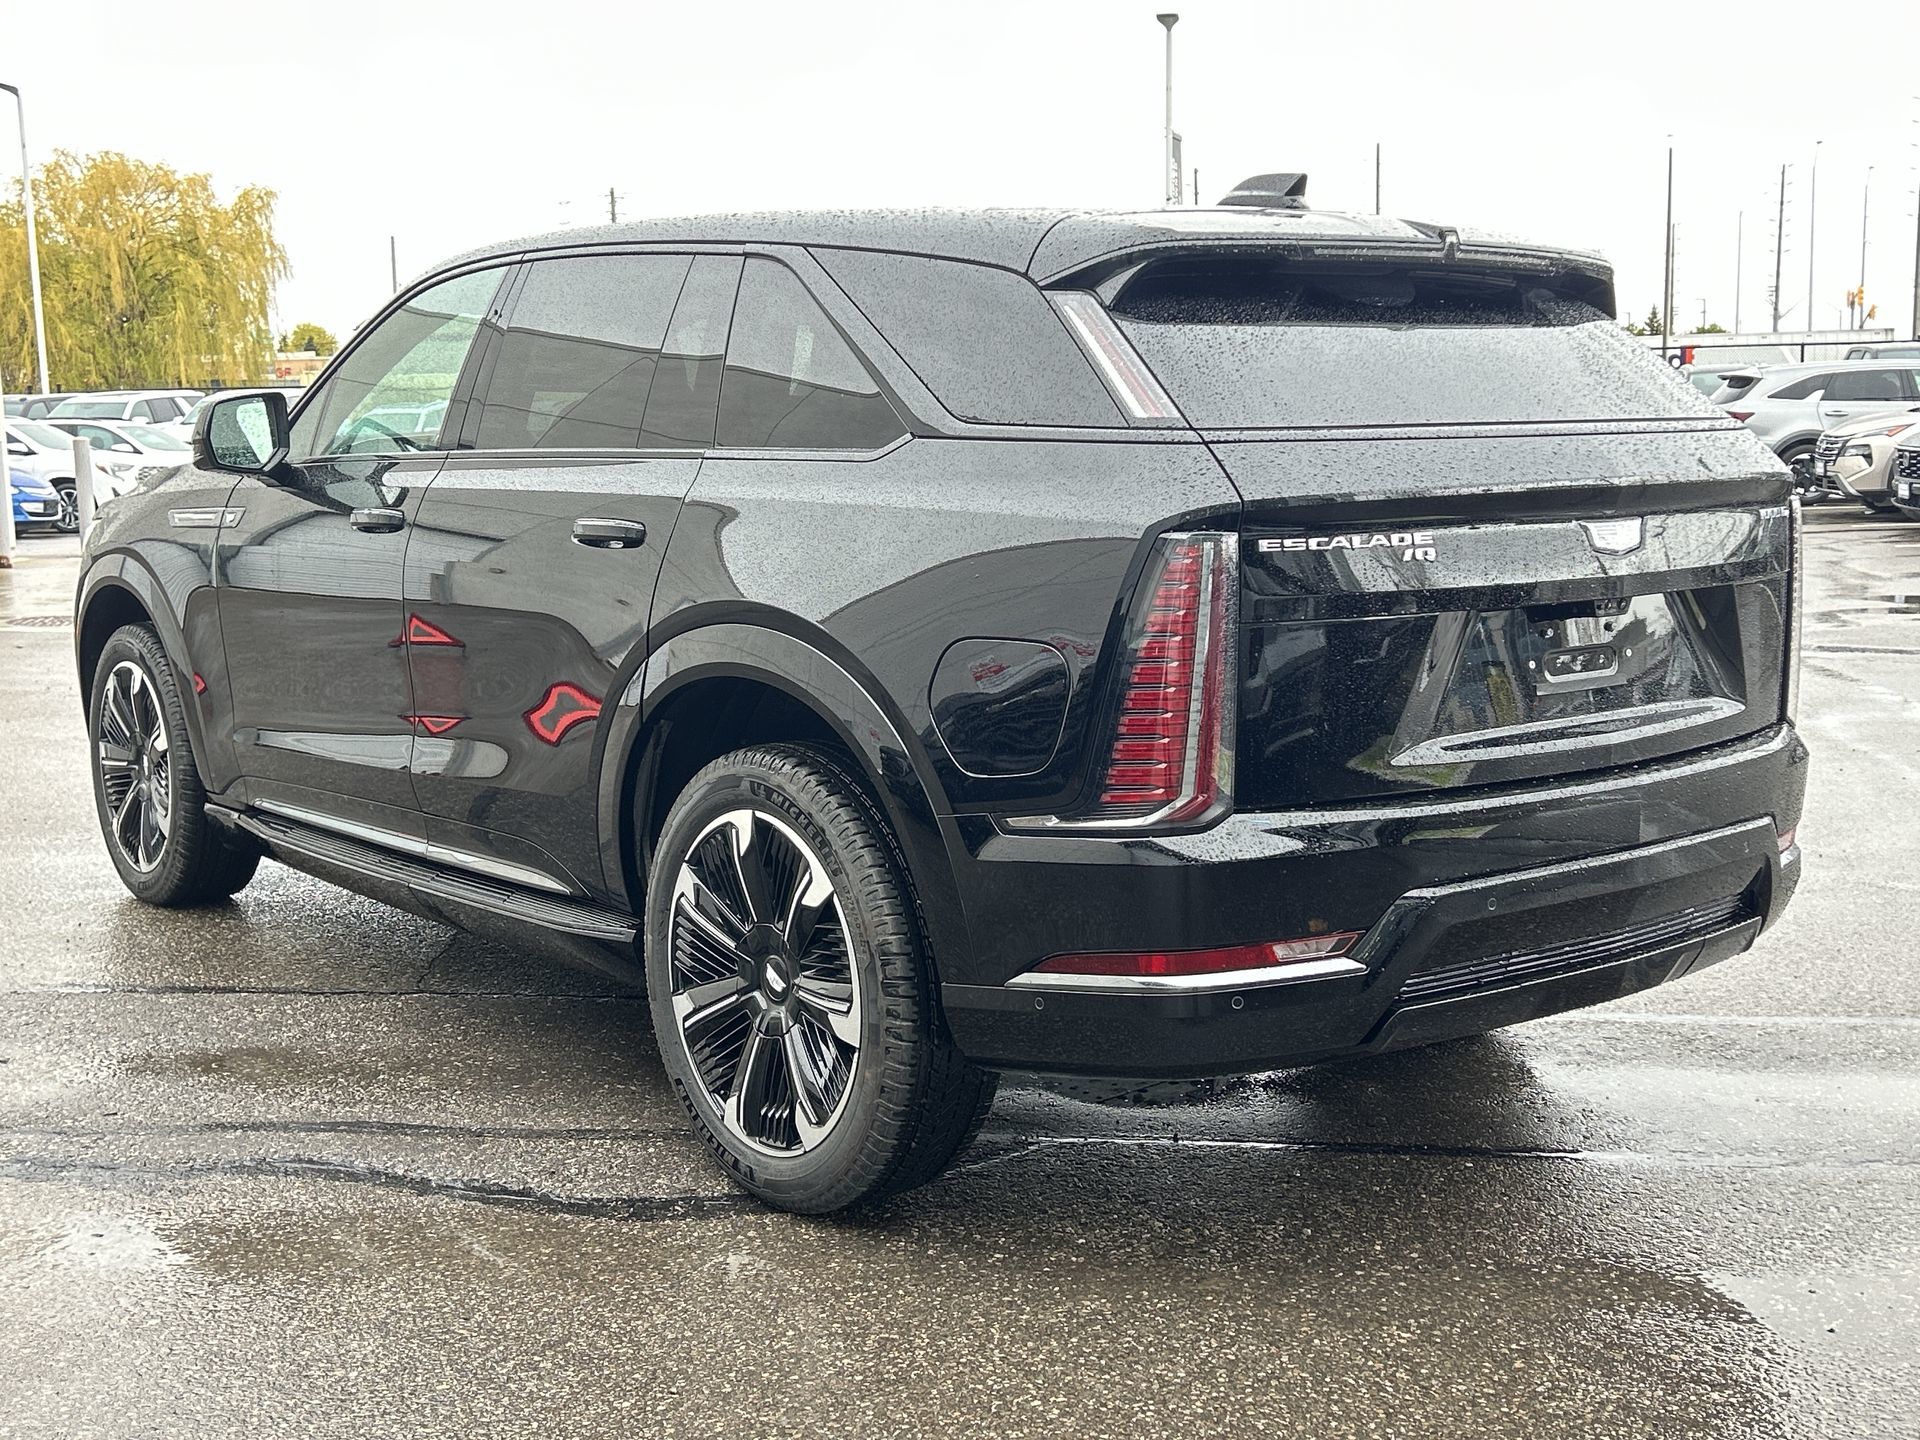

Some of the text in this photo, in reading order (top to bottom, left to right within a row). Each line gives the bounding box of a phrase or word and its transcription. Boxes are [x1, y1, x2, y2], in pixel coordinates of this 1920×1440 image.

[1258, 532, 1433, 552] ESCALADE
[1402, 547, 1437, 562] IQ
[771, 791, 839, 874] MICHELIN
